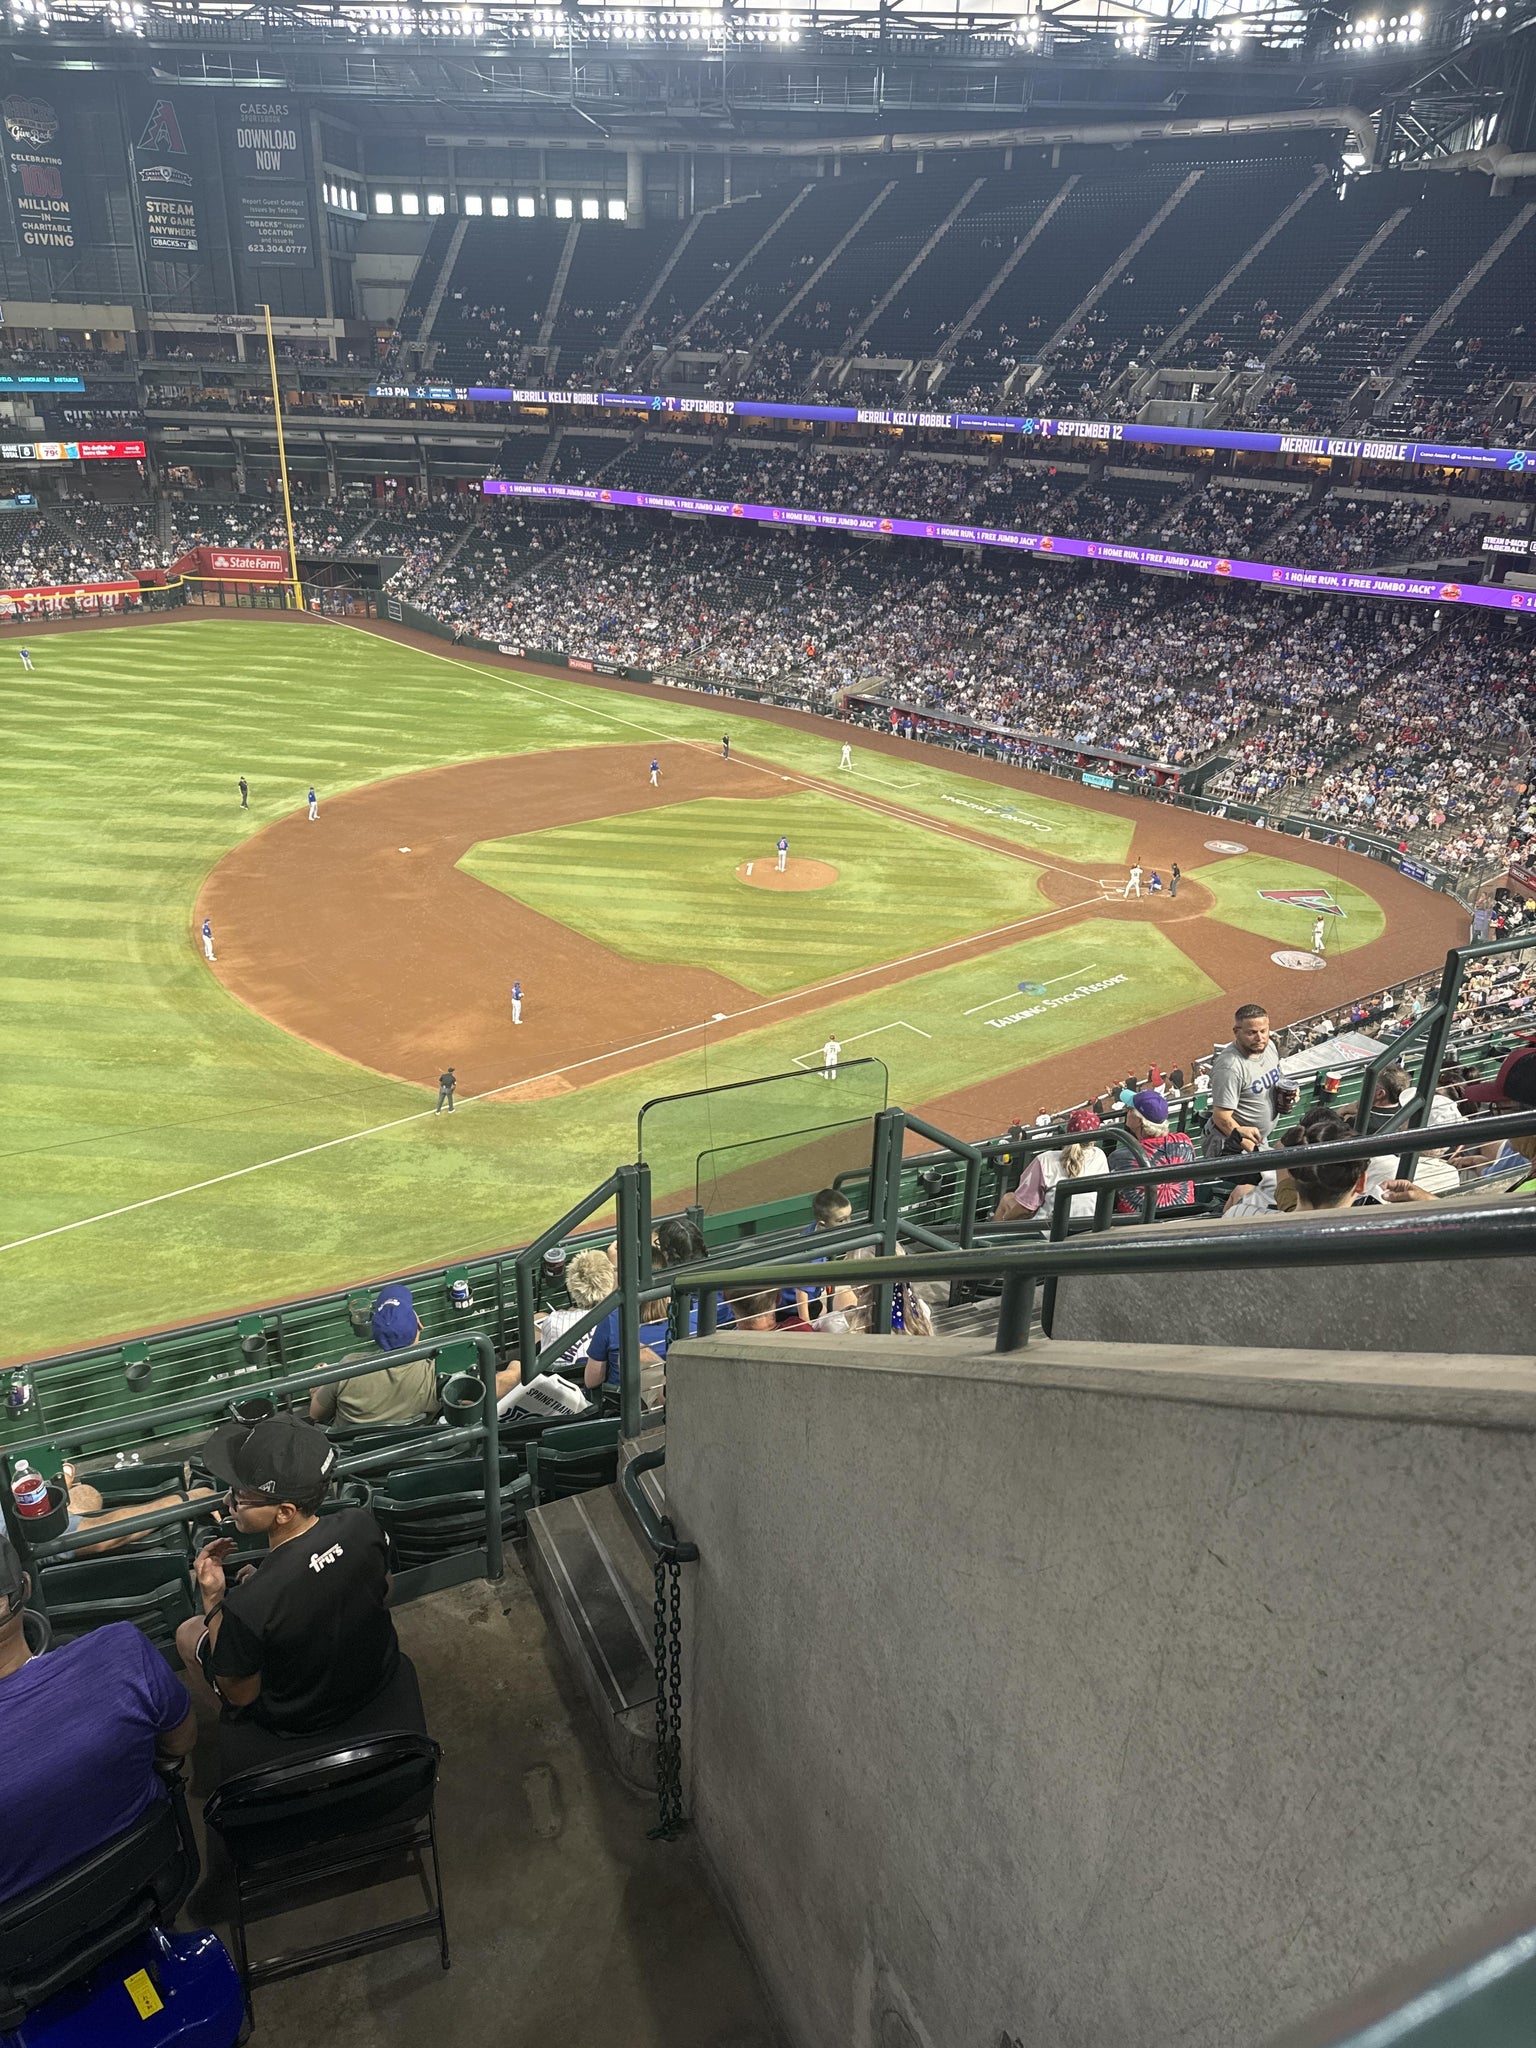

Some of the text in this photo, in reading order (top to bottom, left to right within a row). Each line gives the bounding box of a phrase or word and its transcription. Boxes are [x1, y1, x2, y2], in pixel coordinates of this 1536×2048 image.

[240, 103, 289, 115] CAESARS
[237, 128, 296, 150] DOWNLOAD
[11, 153, 63, 165] CELEBRATING
[255, 150, 280, 171] NOW
[18, 198, 70, 212] MILLION
[146, 201, 194, 215] STREAM
[40, 213, 51, 221] IN
[148, 215, 196, 227] ANY GAME
[22, 222, 73, 233] CHARITABLE
[149, 225, 197, 237] ANYWHERE
[24, 232, 74, 247] GIVING
[248, 244, 307, 254] 623.304.0777
[376, 387, 409, 397] 2:13 PM
[512, 390, 547, 403] MERRILL
[548, 391, 573, 404] KELLY
[573, 393, 598, 405] BOBBLE
[680, 400, 724, 413] SEPTEMBER
[725, 403, 735, 414] 12
[857, 410, 891, 425] MERRILL
[892, 411, 918, 426] KELLY
[919, 413, 951, 428] BOBBLE
[1056, 421, 1111, 438] SEPTEMBER
[1112, 425, 1123, 440] 12
[1279, 437, 1408, 460] MERRILL KELLY BOBBLE
[509, 482, 513, 492] 1
[514, 483, 532, 493] HOME
[552, 485, 566, 495] FREE
[566, 486, 584, 496] JUMBO
[648, 497, 663, 505] HOME
[681, 501, 694, 509] FREE
[694, 502, 713, 511] JUMBO
[786, 512, 803, 520] HOME
[803, 514, 817, 523] RUN,
[822, 516, 837, 524] FREE
[837, 518, 858, 526] JUMBO
[941, 528, 959, 537] HOME
[960, 530, 975, 539] RUN,
[981, 532, 996, 541] FREE
[997, 534, 1019, 543] JUMBO
[1481, 543, 1528, 554] BASEBALL
[230, 556, 280, 569] State Farm
[1098, 547, 1102, 555] 1
[1102, 548, 1123, 558] HOME
[1124, 550, 1139, 560] RUN,
[1141, 552, 1145, 560] 1
[1145, 553, 1164, 563] FREE
[1164, 556, 1189, 566] JUMBO
[1284, 572, 1290, 580] 1
[1290, 572, 1317, 584] HOME
[1318, 575, 1340, 586] RUN,
[1341, 578, 1347, 587] 1
[1348, 579, 1372, 589] FREE
[1372, 582, 1406, 592] JUMBO
[23, 589, 120, 613] State Farm
[526, 1387, 553, 1406] SPRING
